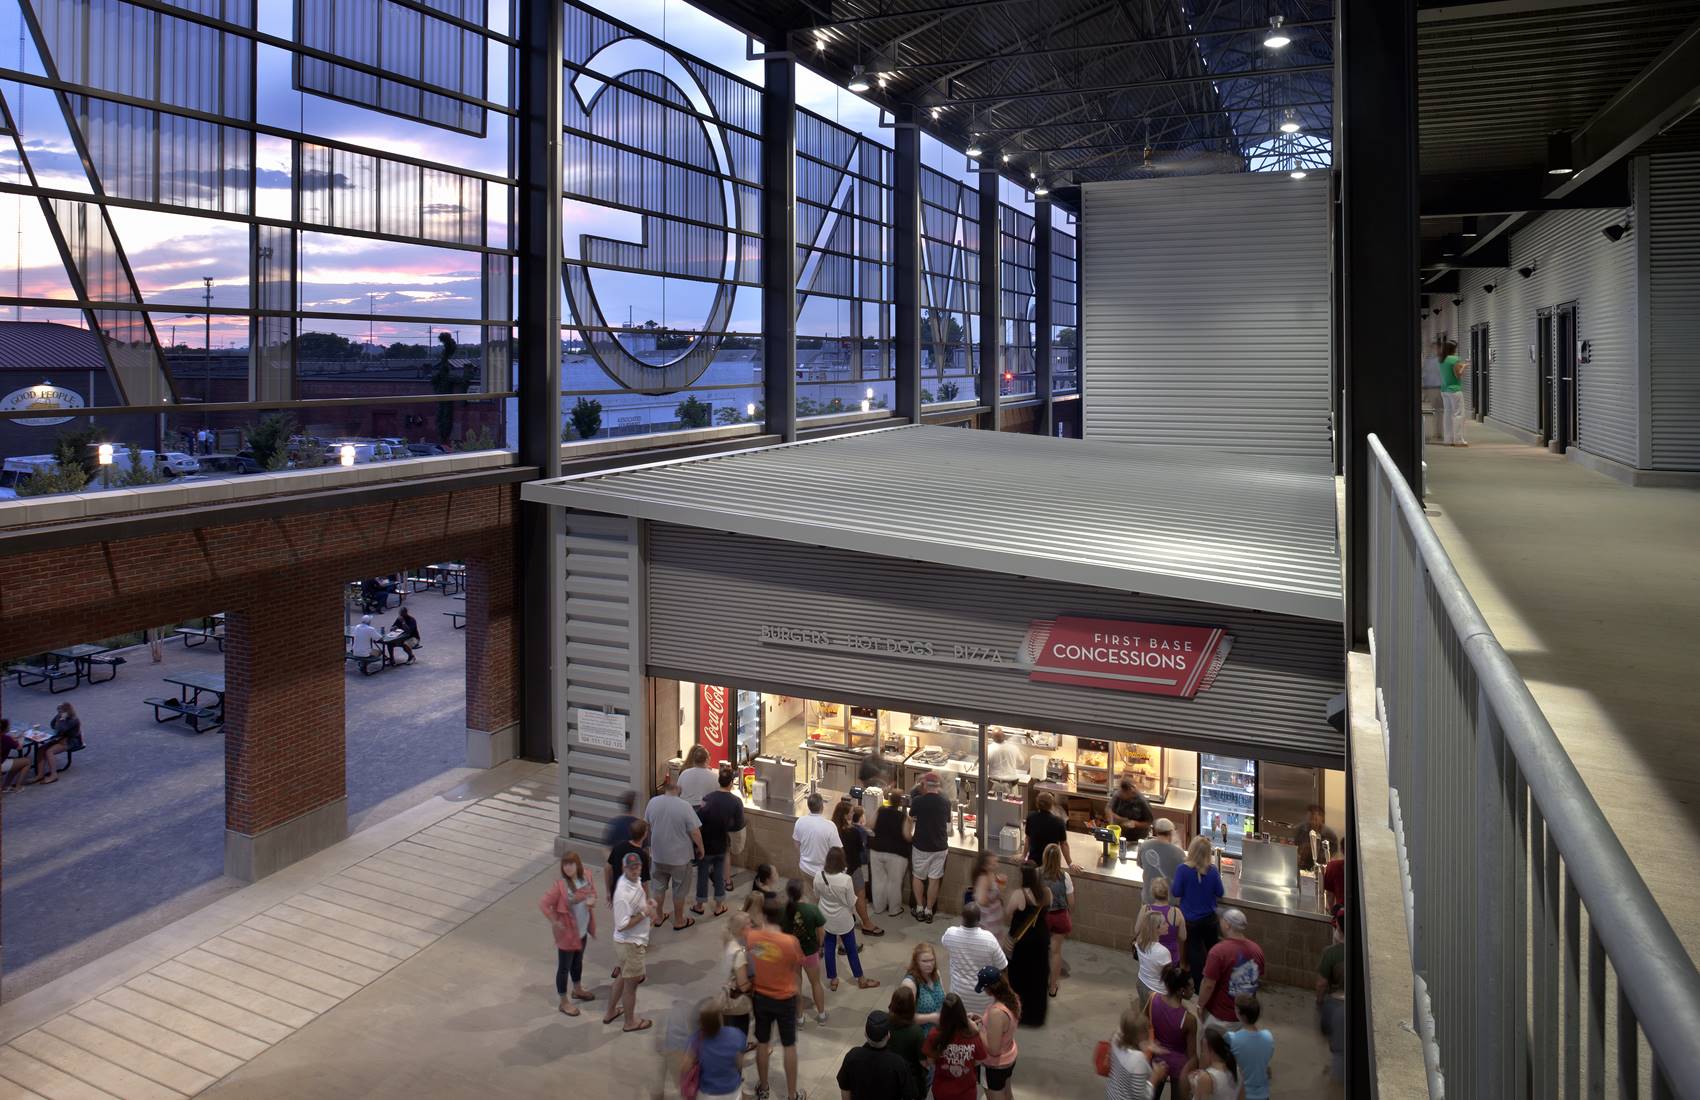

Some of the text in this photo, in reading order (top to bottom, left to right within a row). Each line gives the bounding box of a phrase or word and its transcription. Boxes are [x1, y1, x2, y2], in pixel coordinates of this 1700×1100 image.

[41, 391, 76, 403] PEOPLE
[761, 625, 1002, 663] BURGERS HOT DOGS PIZZA
[1094, 633, 1192, 652] FIRST BASE
[1053, 643, 1186, 670] CONCESSIONS
